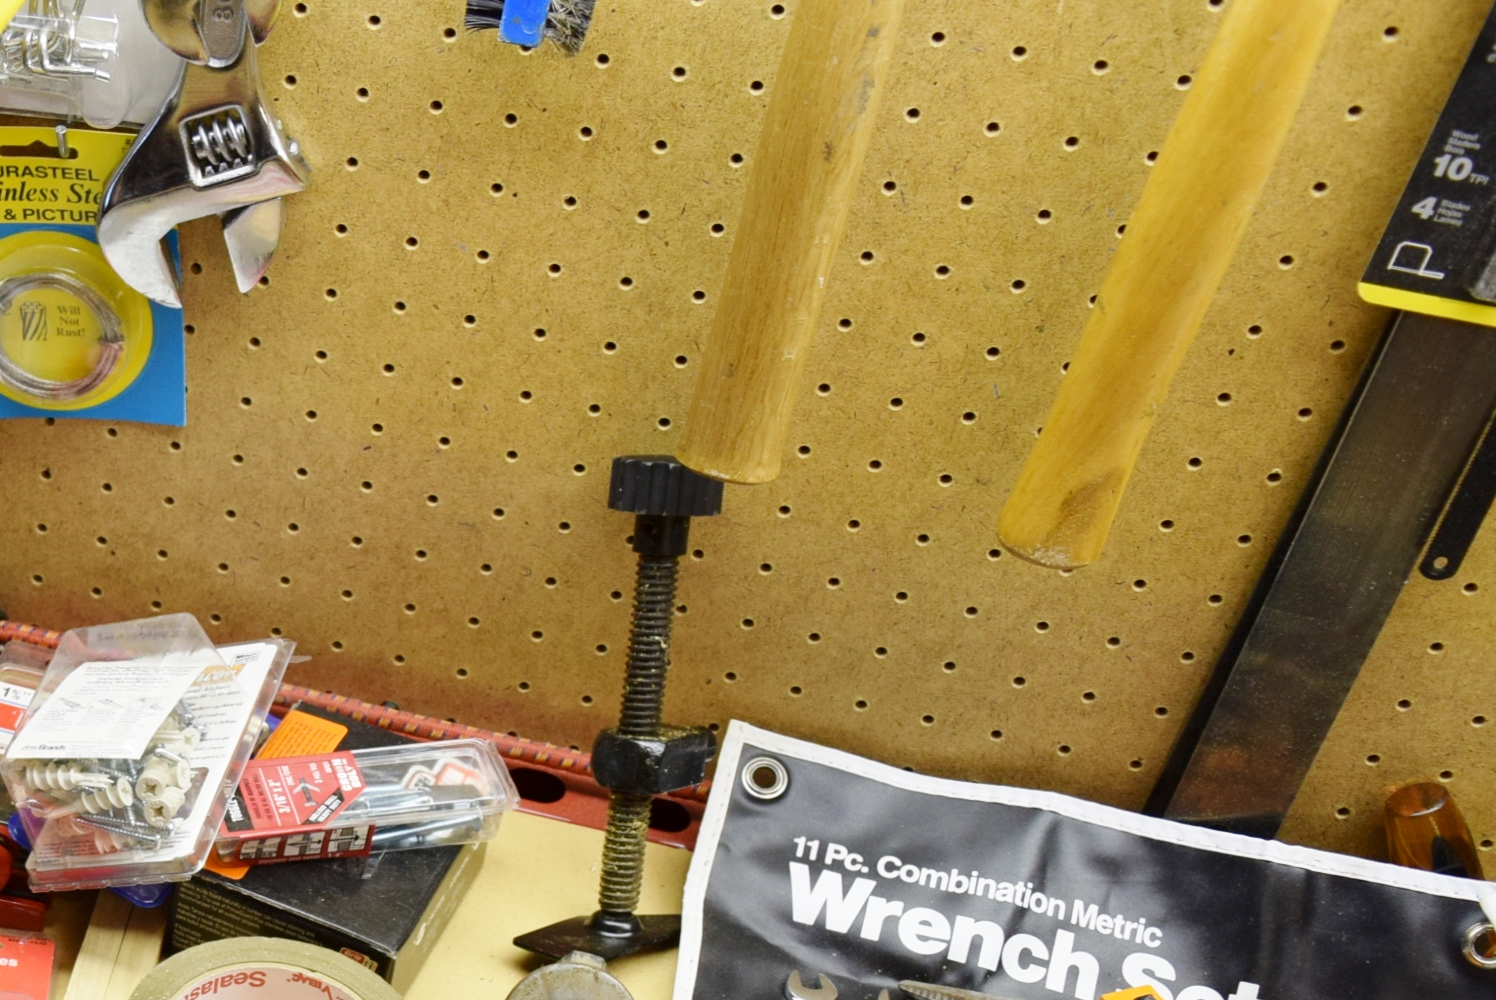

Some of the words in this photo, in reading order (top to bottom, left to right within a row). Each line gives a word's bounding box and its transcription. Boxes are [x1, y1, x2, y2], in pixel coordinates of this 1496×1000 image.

[1434, 154, 1473, 181] 10
[4, 209, 16, 221] &
[1411, 196, 1437, 220] 4
[57, 305, 81, 315] Will
[59, 316, 80, 326] Not
[56, 326, 85, 338] Rust!
[331, 759, 353, 791] CROWN
[792, 836, 819, 862] 11
[823, 842, 869, 874] Pc.
[876, 854, 1066, 921] Combination
[1070, 899, 1164, 949] Metric
